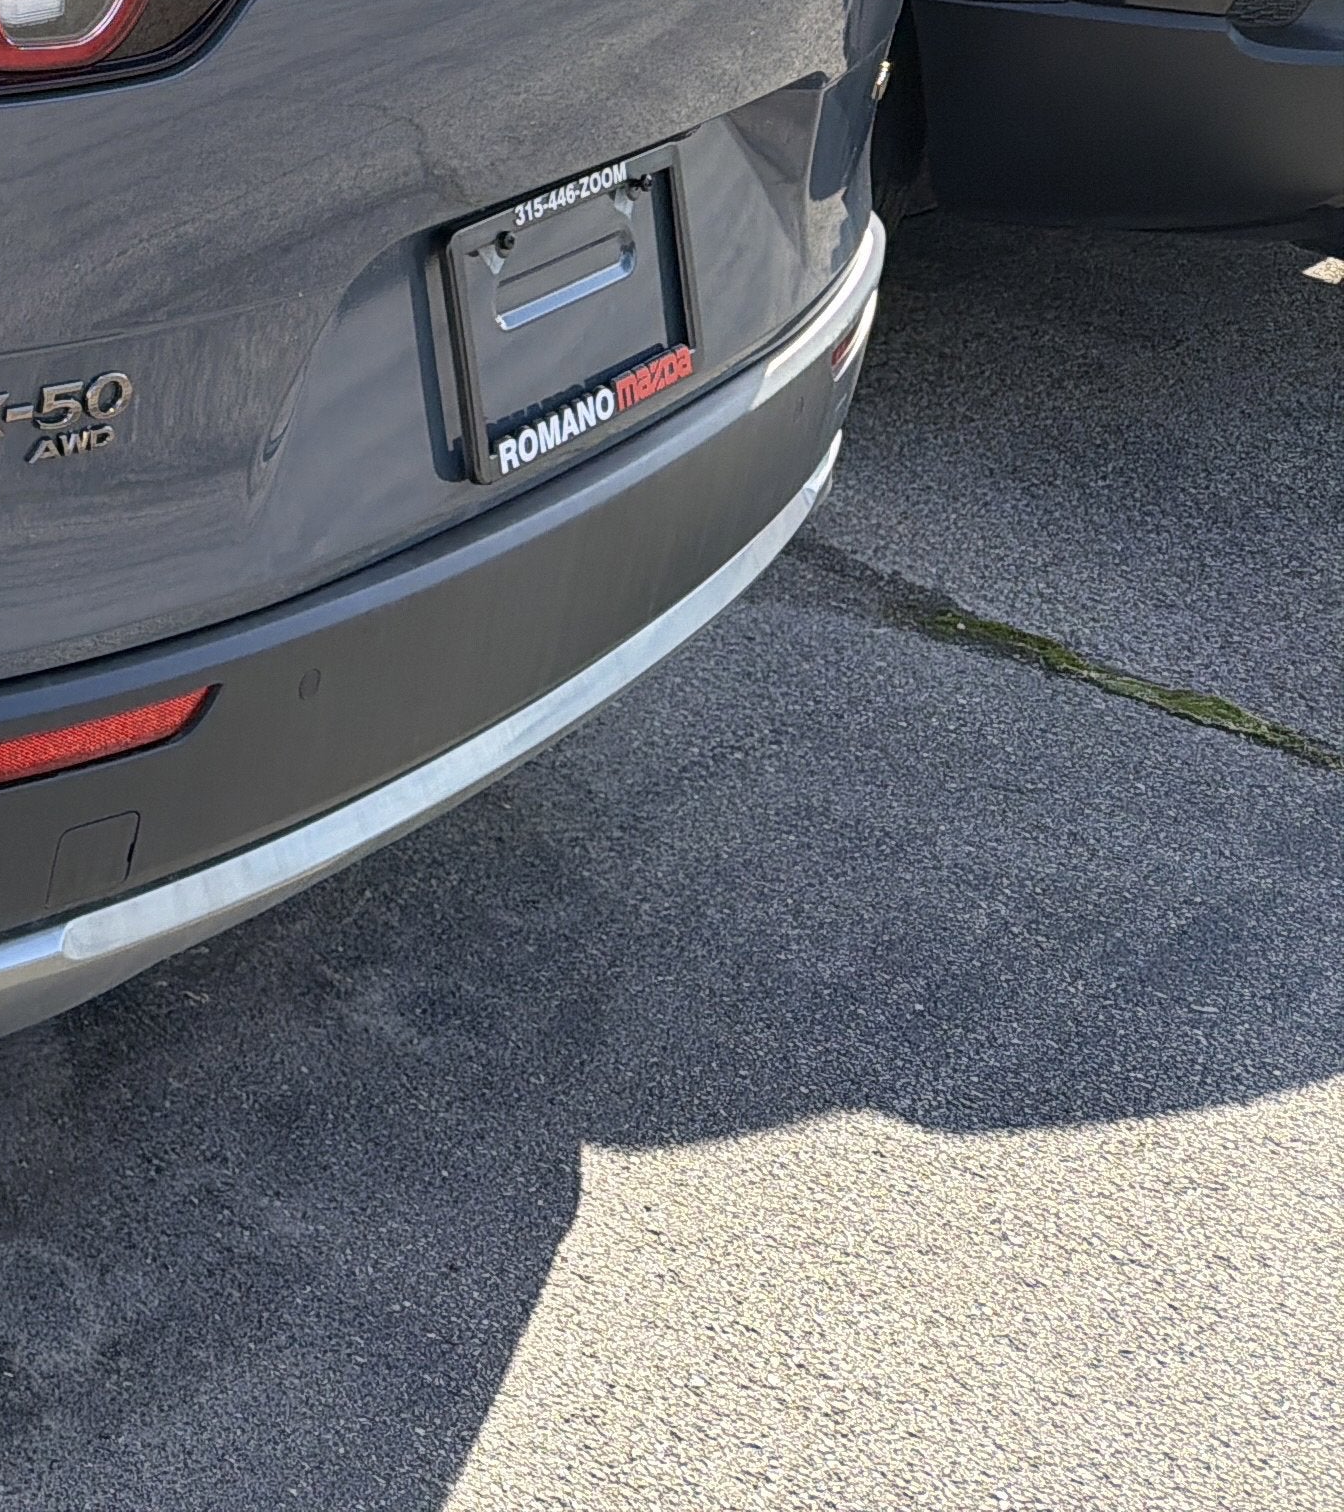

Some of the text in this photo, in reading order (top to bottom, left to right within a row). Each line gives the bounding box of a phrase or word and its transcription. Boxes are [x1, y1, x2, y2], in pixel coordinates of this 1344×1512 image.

[514, 161, 628, 226] 315-446-ZOOM
[26, 424, 116, 464] AWD
[499, 387, 615, 475] ROMANO
